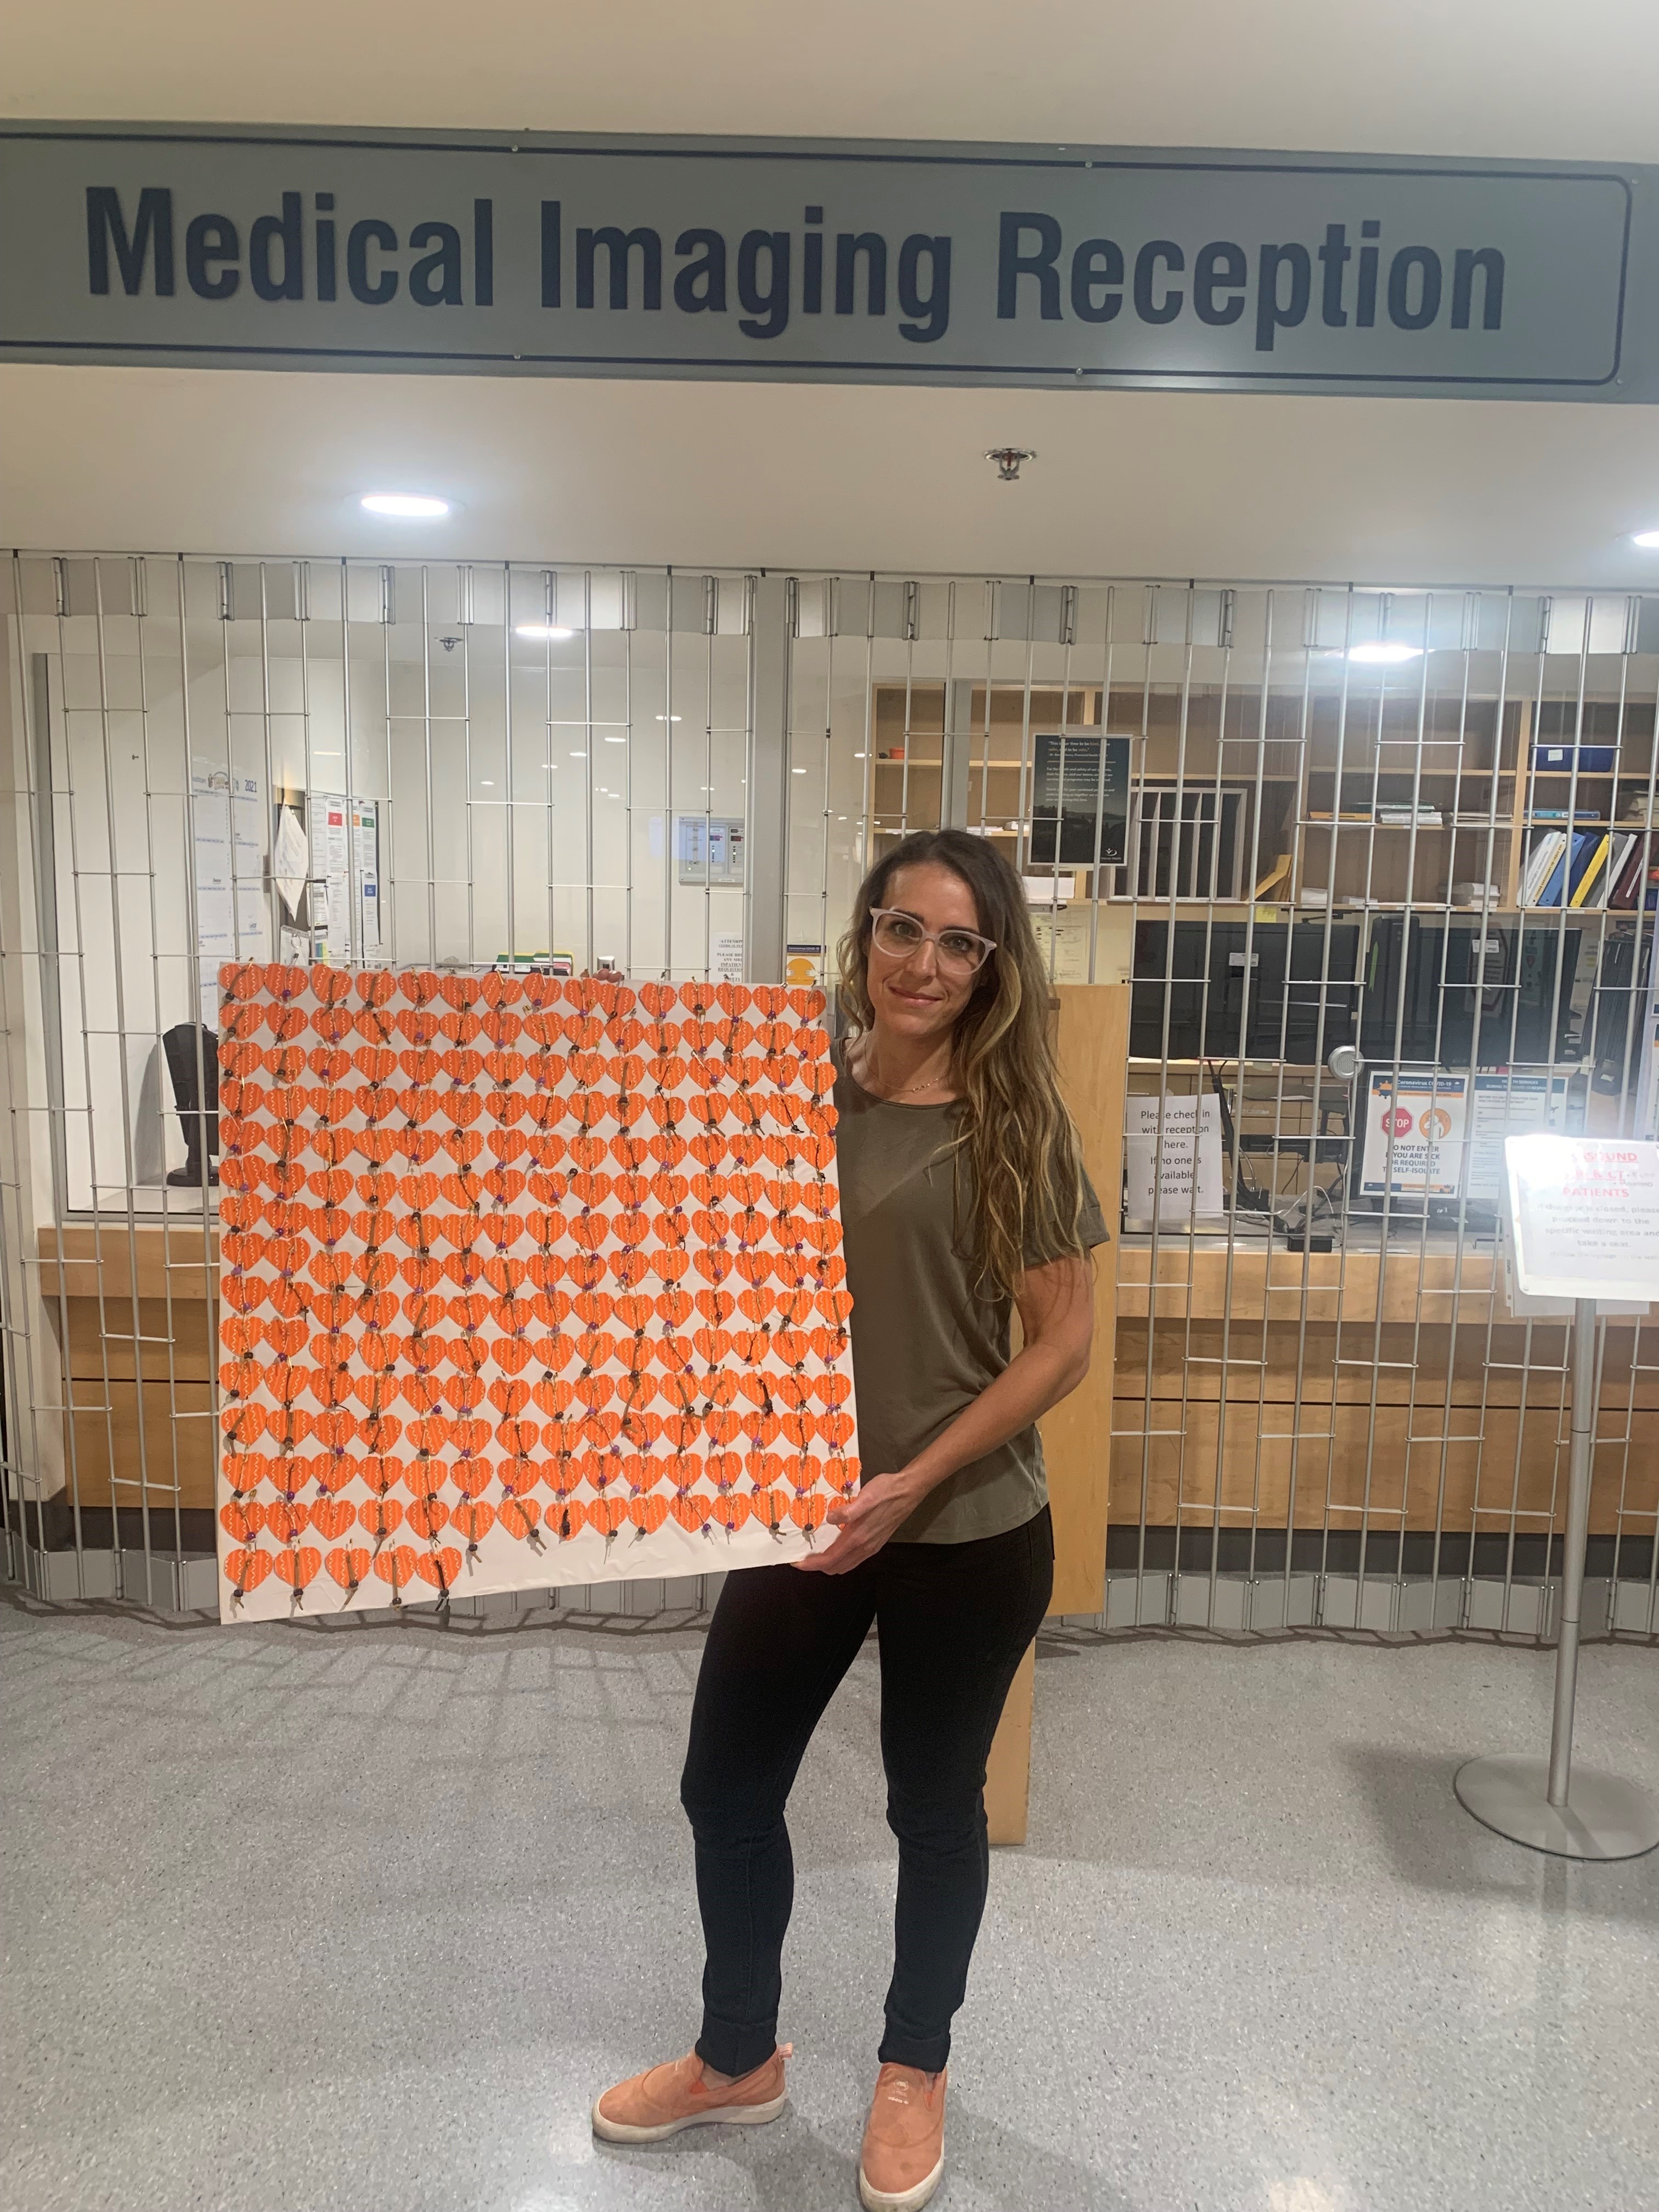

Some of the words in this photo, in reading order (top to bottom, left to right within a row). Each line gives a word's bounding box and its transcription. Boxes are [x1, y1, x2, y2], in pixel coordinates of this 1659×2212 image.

[86, 186, 493, 307] Medical
[541, 200, 951, 343] Imaging
[996, 211, 1505, 352] Reception
[245, 780, 257, 793] 2021
[1141, 1110, 1171, 1119] Pleae
[1173, 1110, 1198, 1119] chec
[1142, 1125, 1159, 1134] wit
[1166, 1126, 1209, 1135] recepton
[1164, 1140, 1188, 1149] here.
[1149, 1187, 1178, 1196] pease
[1563, 1188, 1629, 1198] PATIENTS
[1596, 1205, 1629, 1213] closed,
[1545, 1227, 1579, 1235] specific
[1582, 1228, 1617, 1237] waiting
